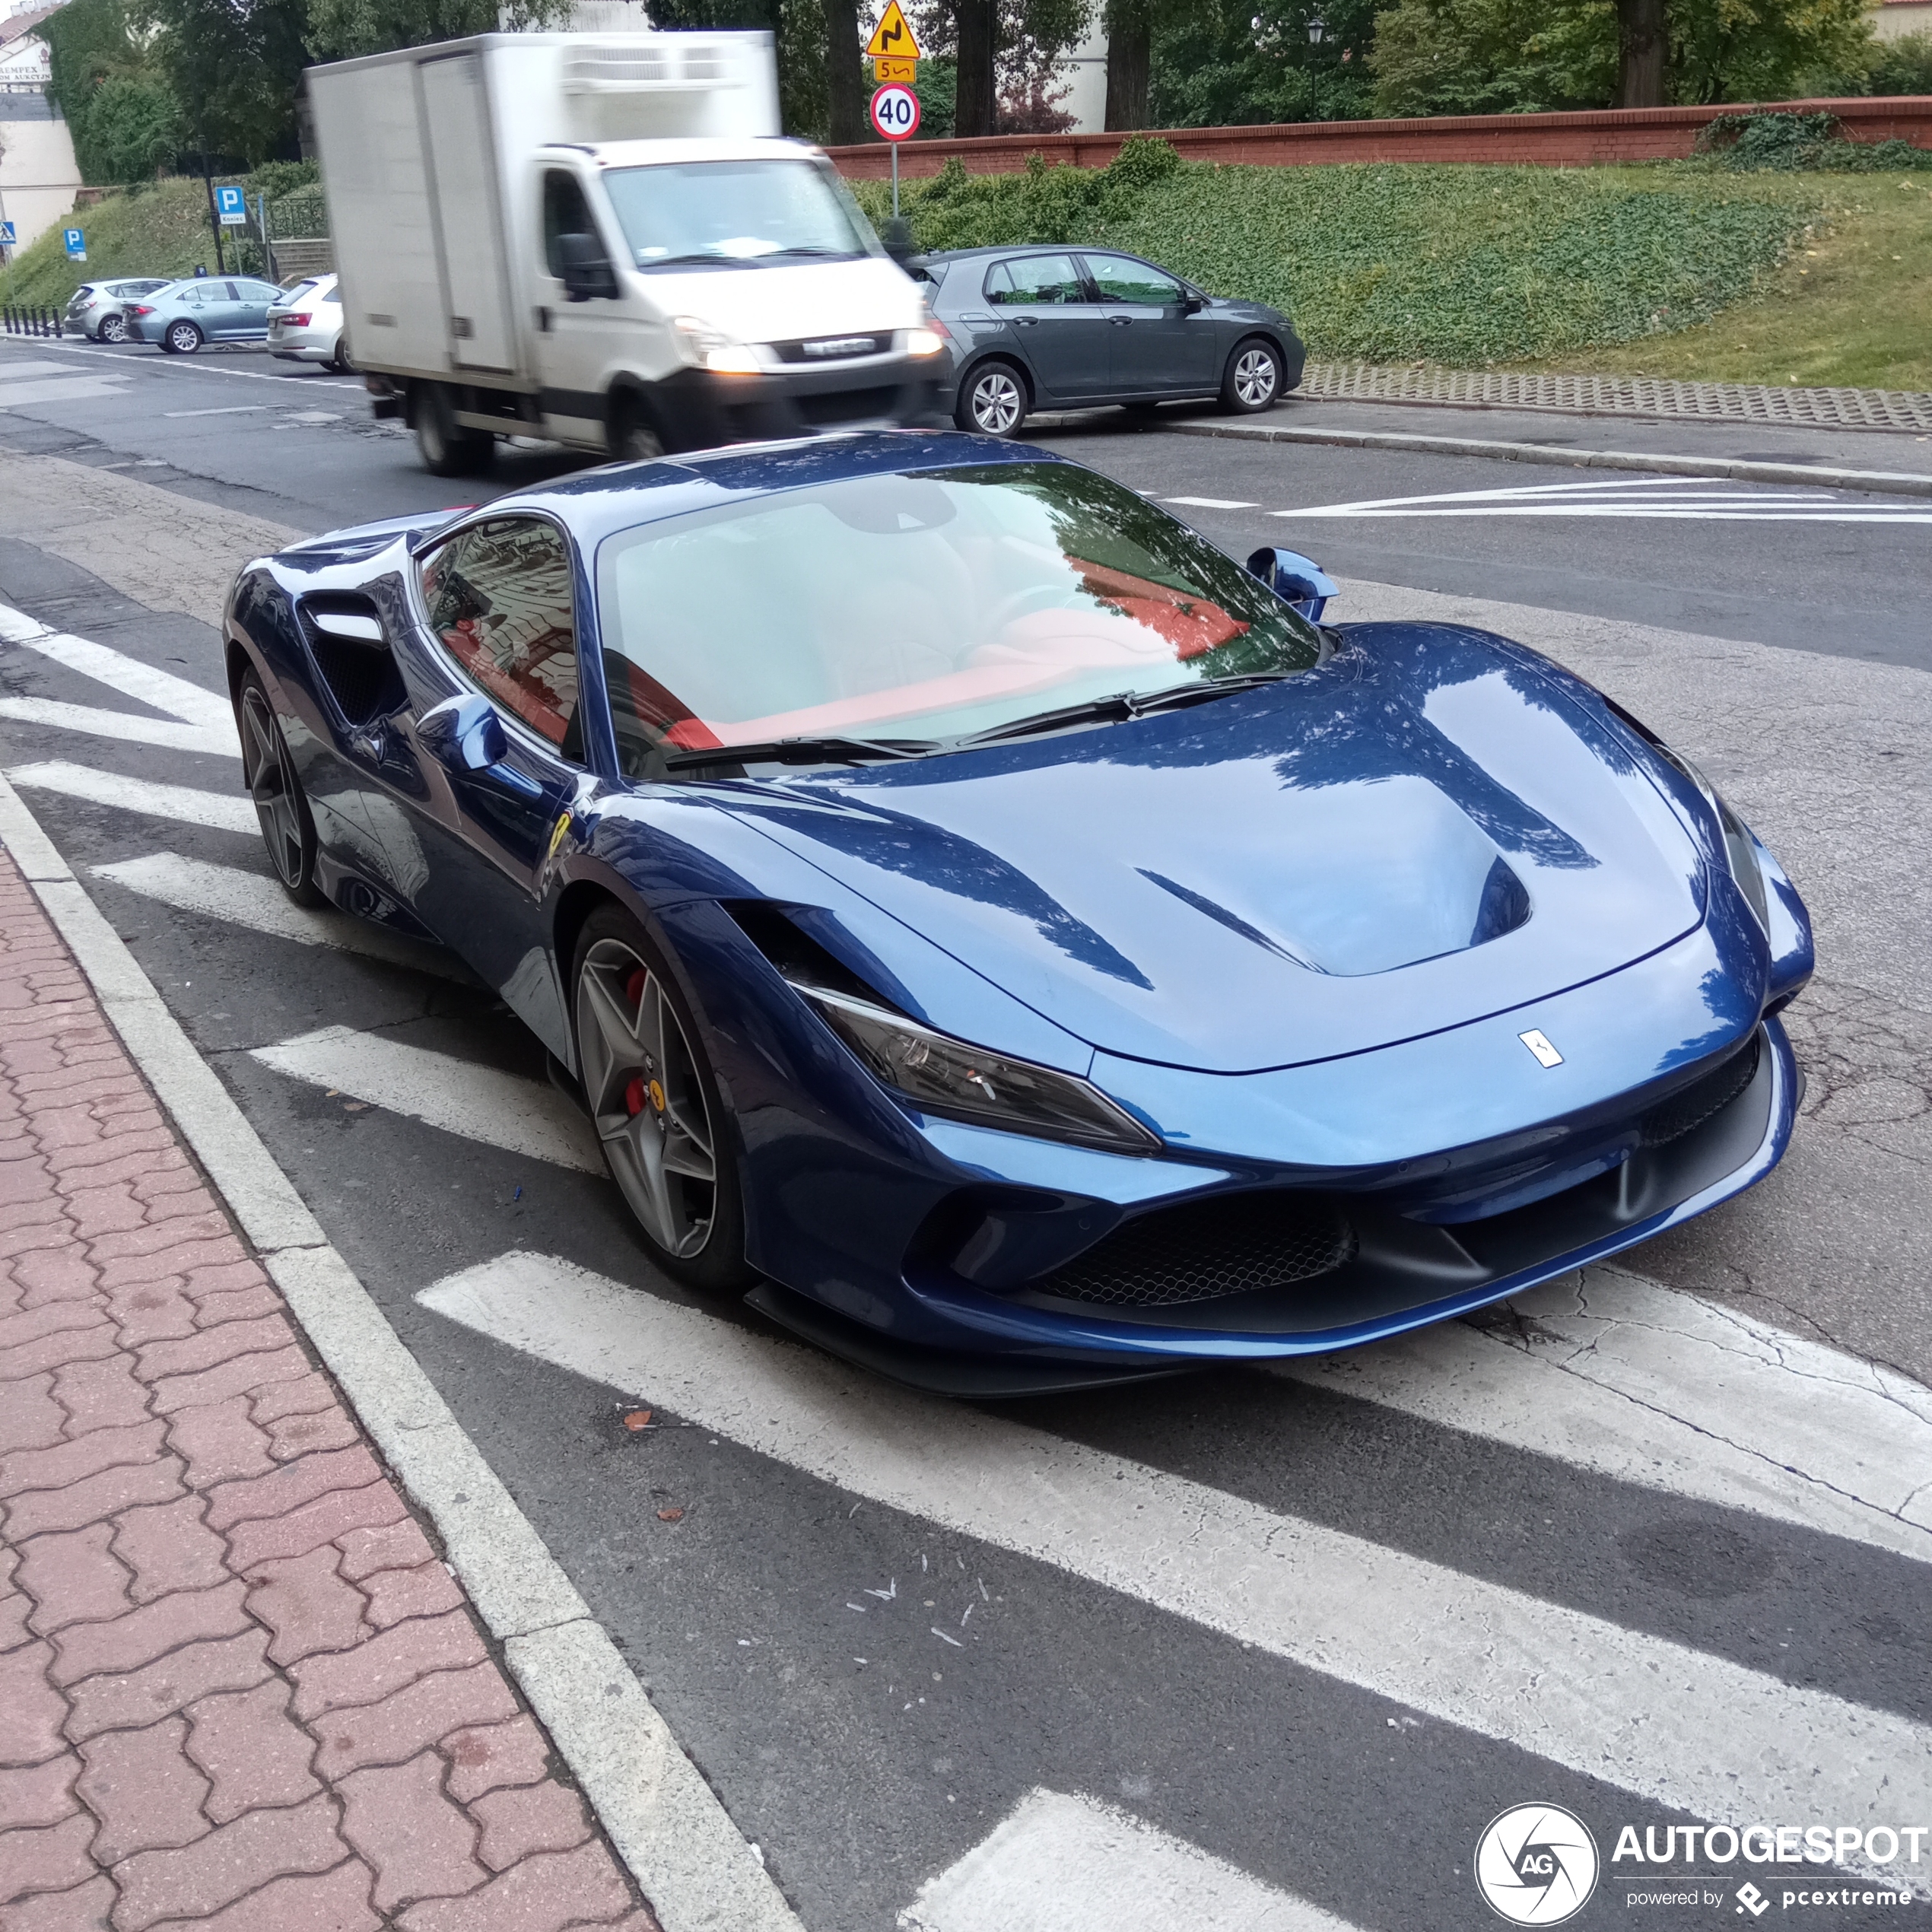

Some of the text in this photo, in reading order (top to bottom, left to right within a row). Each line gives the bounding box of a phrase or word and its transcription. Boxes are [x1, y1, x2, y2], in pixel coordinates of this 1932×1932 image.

[881, 62, 890, 78] 5
[879, 97, 910, 125] 40
[222, 189, 238, 211] P
[68, 230, 79, 246] P
